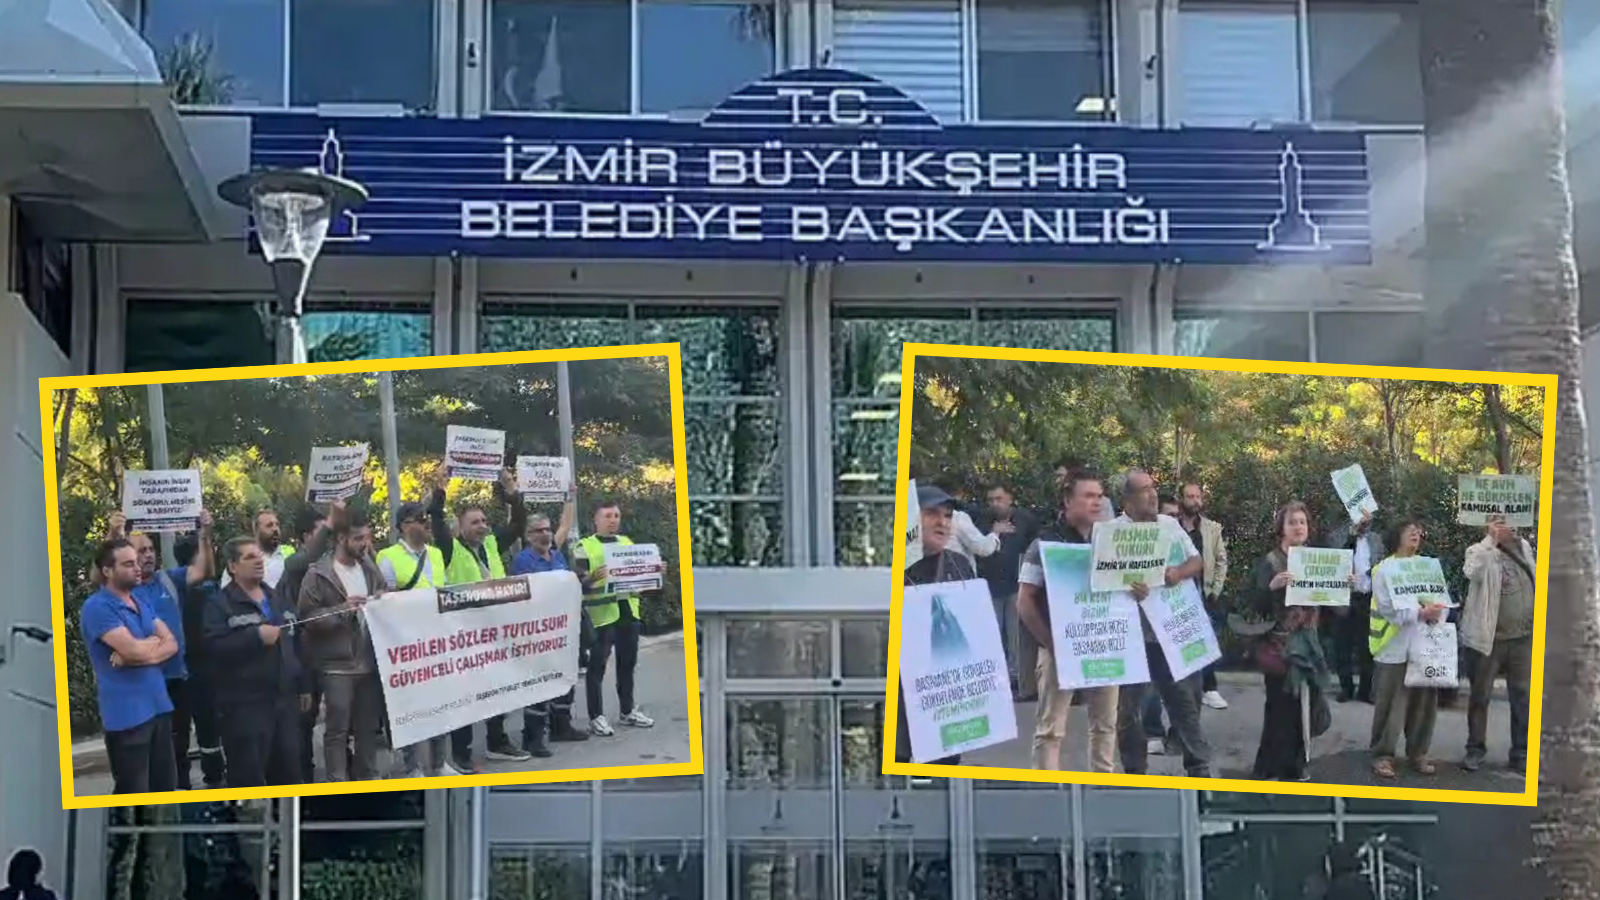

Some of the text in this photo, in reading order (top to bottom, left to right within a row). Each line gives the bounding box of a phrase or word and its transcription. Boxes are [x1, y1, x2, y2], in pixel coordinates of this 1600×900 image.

[777, 88, 883, 124] T.C.
[504, 136, 1127, 195] İZMİR BÜYÜKŞEHİR
[461, 195, 1169, 251] BELEDİYE BAŞKANLIĞI
[141, 486, 188, 494] TARAFINDAN
[1475, 478, 1515, 490] NE AVM
[1461, 490, 1475, 501] NE
[1461, 502, 1502, 514] KAMUSAL
[1112, 526, 1160, 542] BASMANE
[1115, 541, 1155, 559] ÇUKURU
[1394, 584, 1429, 595] KAMUSAL
[387, 614, 569, 666] VERİLEN SÖZLER TUTULSUN!
[389, 635, 568, 690] GÜVENCELİ ÇALIŞMAK İSTİYORUZ!
